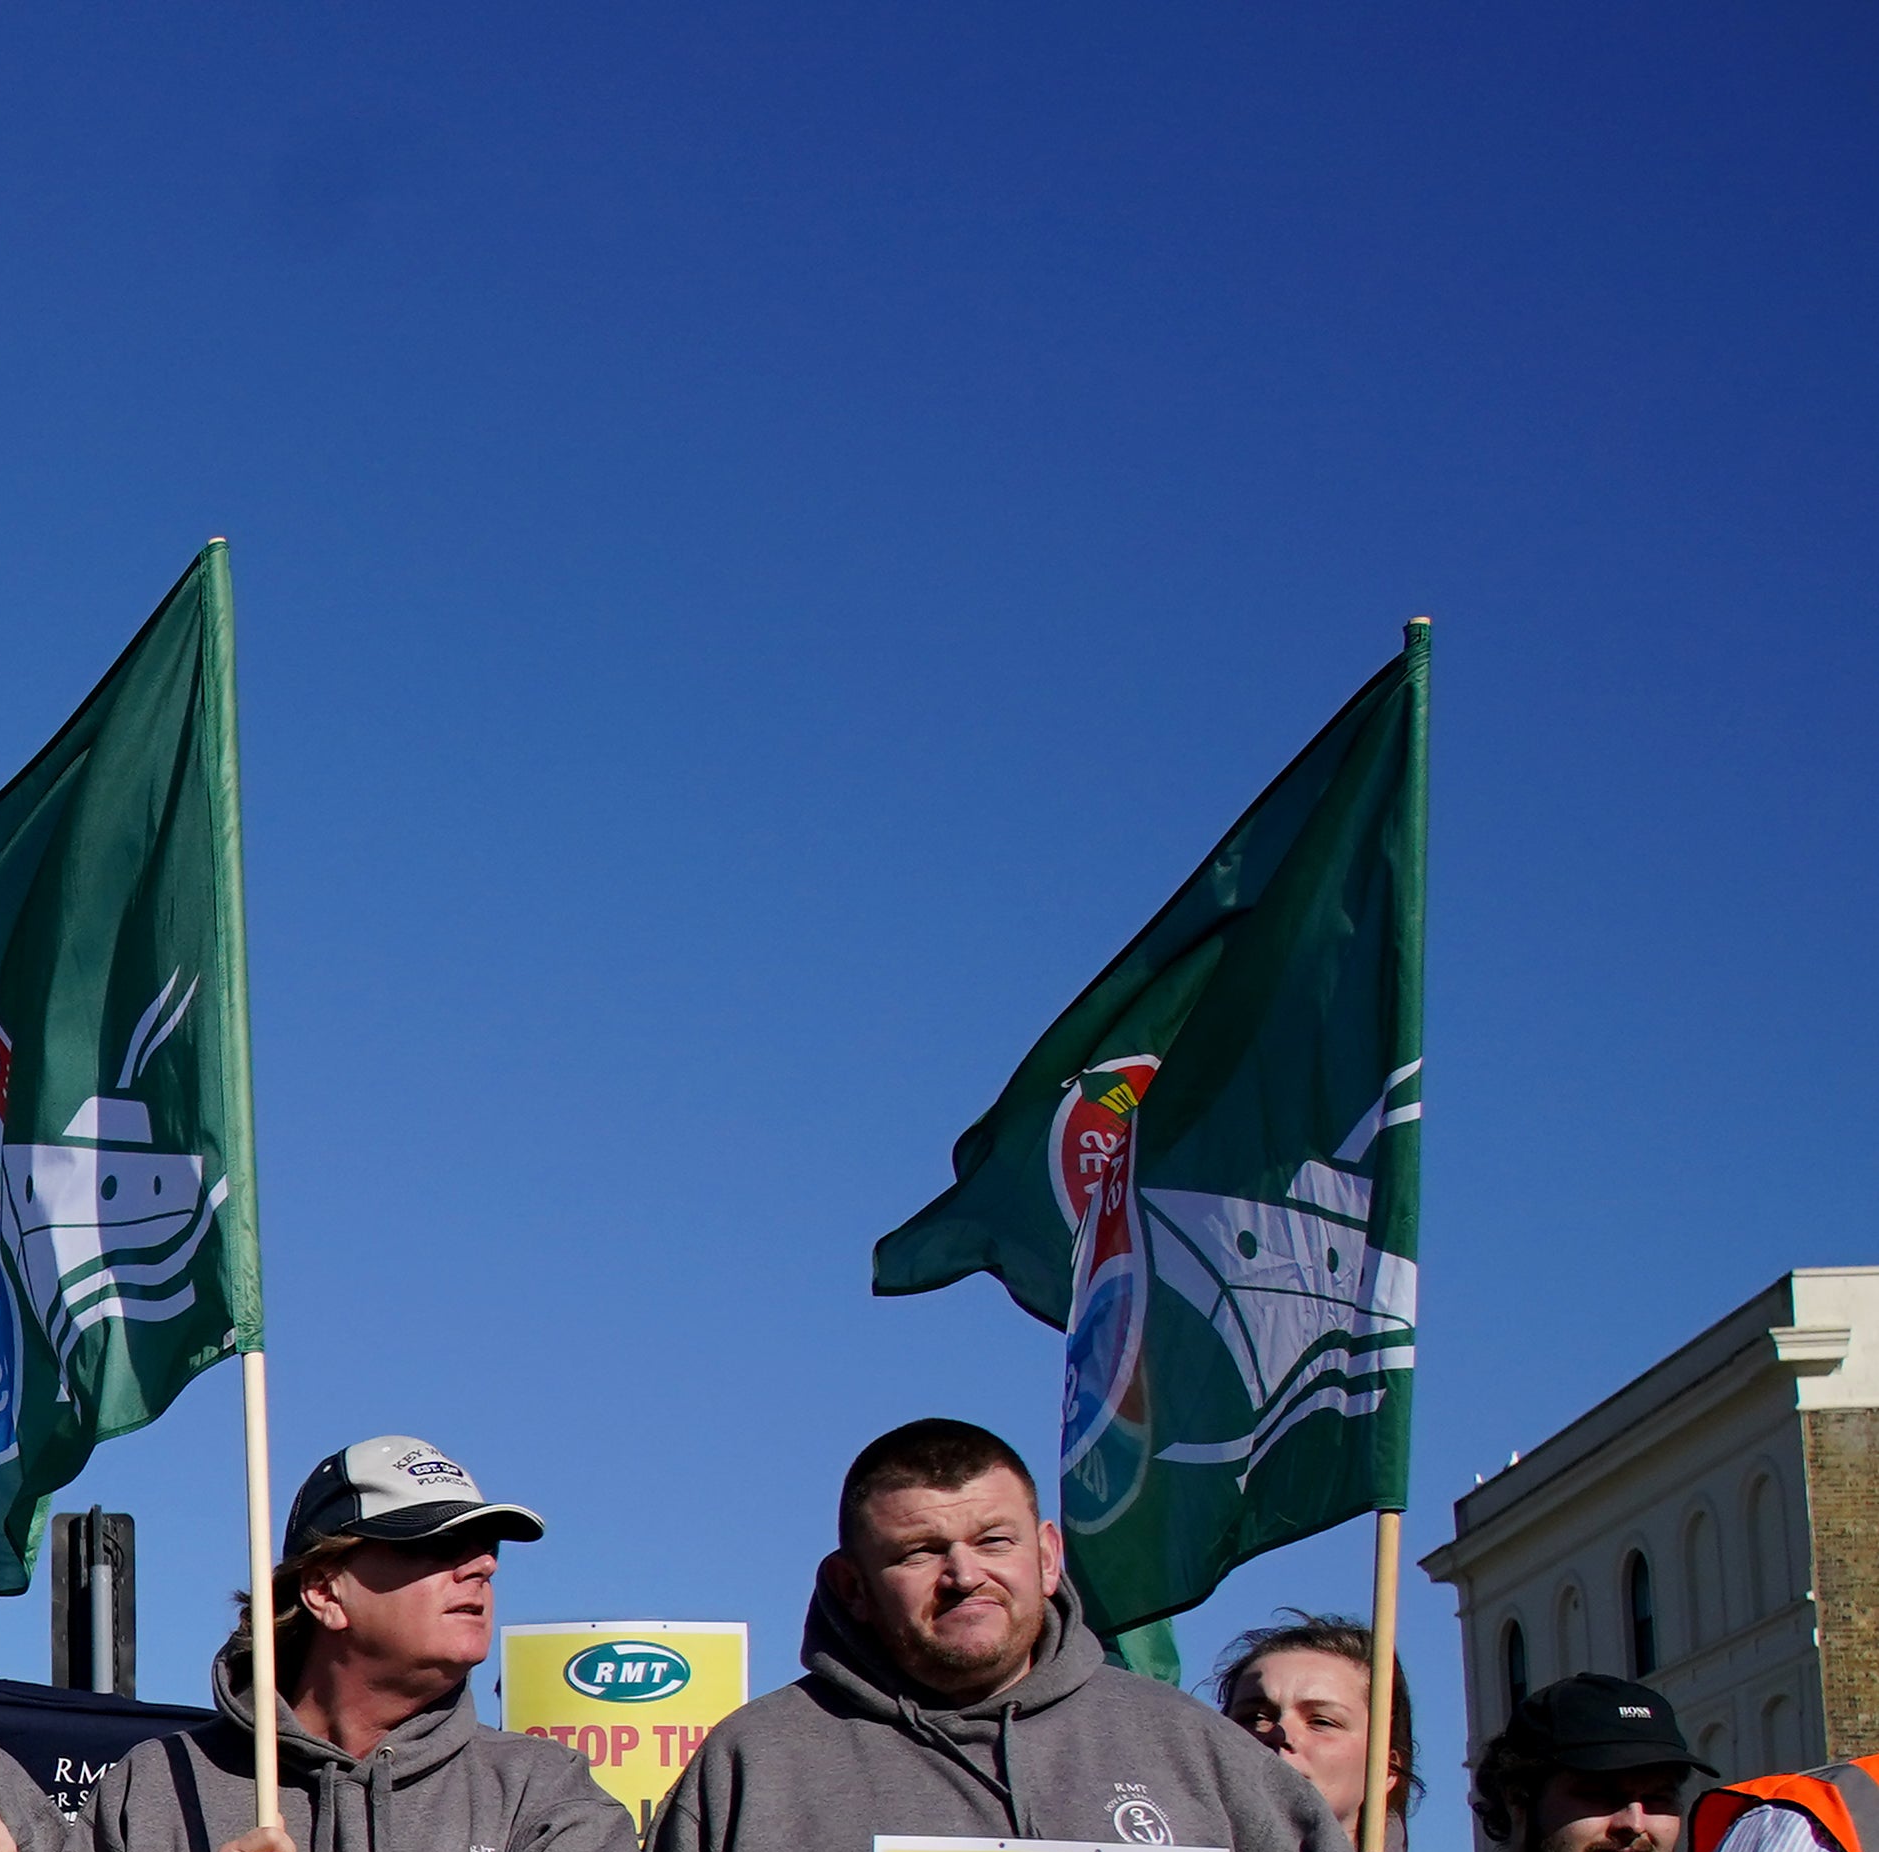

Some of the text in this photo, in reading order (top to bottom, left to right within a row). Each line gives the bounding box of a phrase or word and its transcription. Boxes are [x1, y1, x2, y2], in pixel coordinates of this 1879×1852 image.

[392, 1449, 423, 1471] KEY
[594, 1661, 669, 1684] RMT
[652, 1726, 715, 1768] TH
[54, 1758, 117, 1785] RM
[1113, 1782, 1148, 1794] RMT
